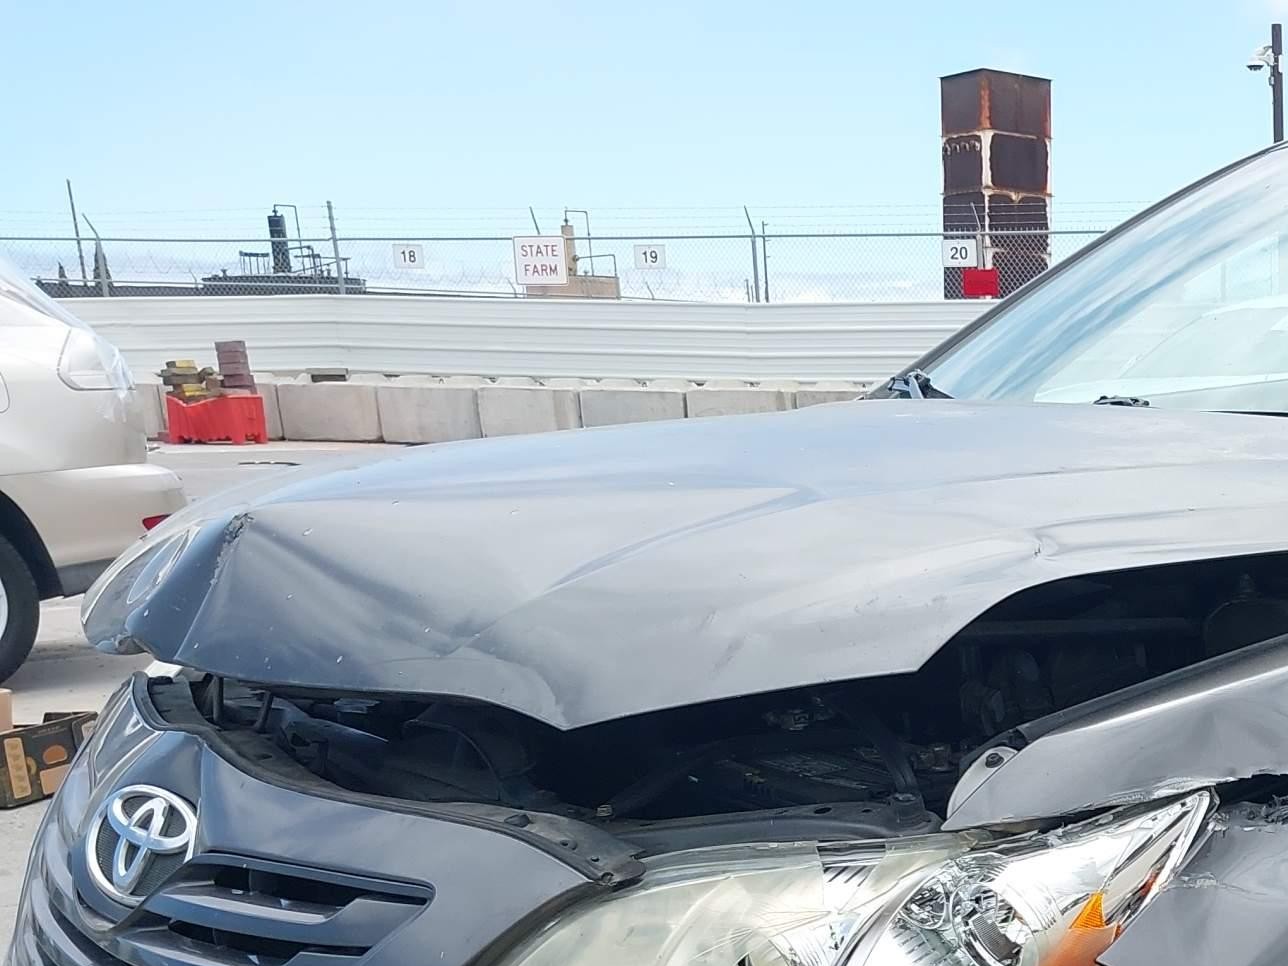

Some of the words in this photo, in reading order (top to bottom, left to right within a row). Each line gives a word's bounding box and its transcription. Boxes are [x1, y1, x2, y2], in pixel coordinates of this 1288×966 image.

[399, 250, 417, 264] 18
[520, 244, 559, 257] STATE
[641, 250, 659, 264] 19
[950, 246, 968, 260] 20
[524, 263, 559, 277] FARM
